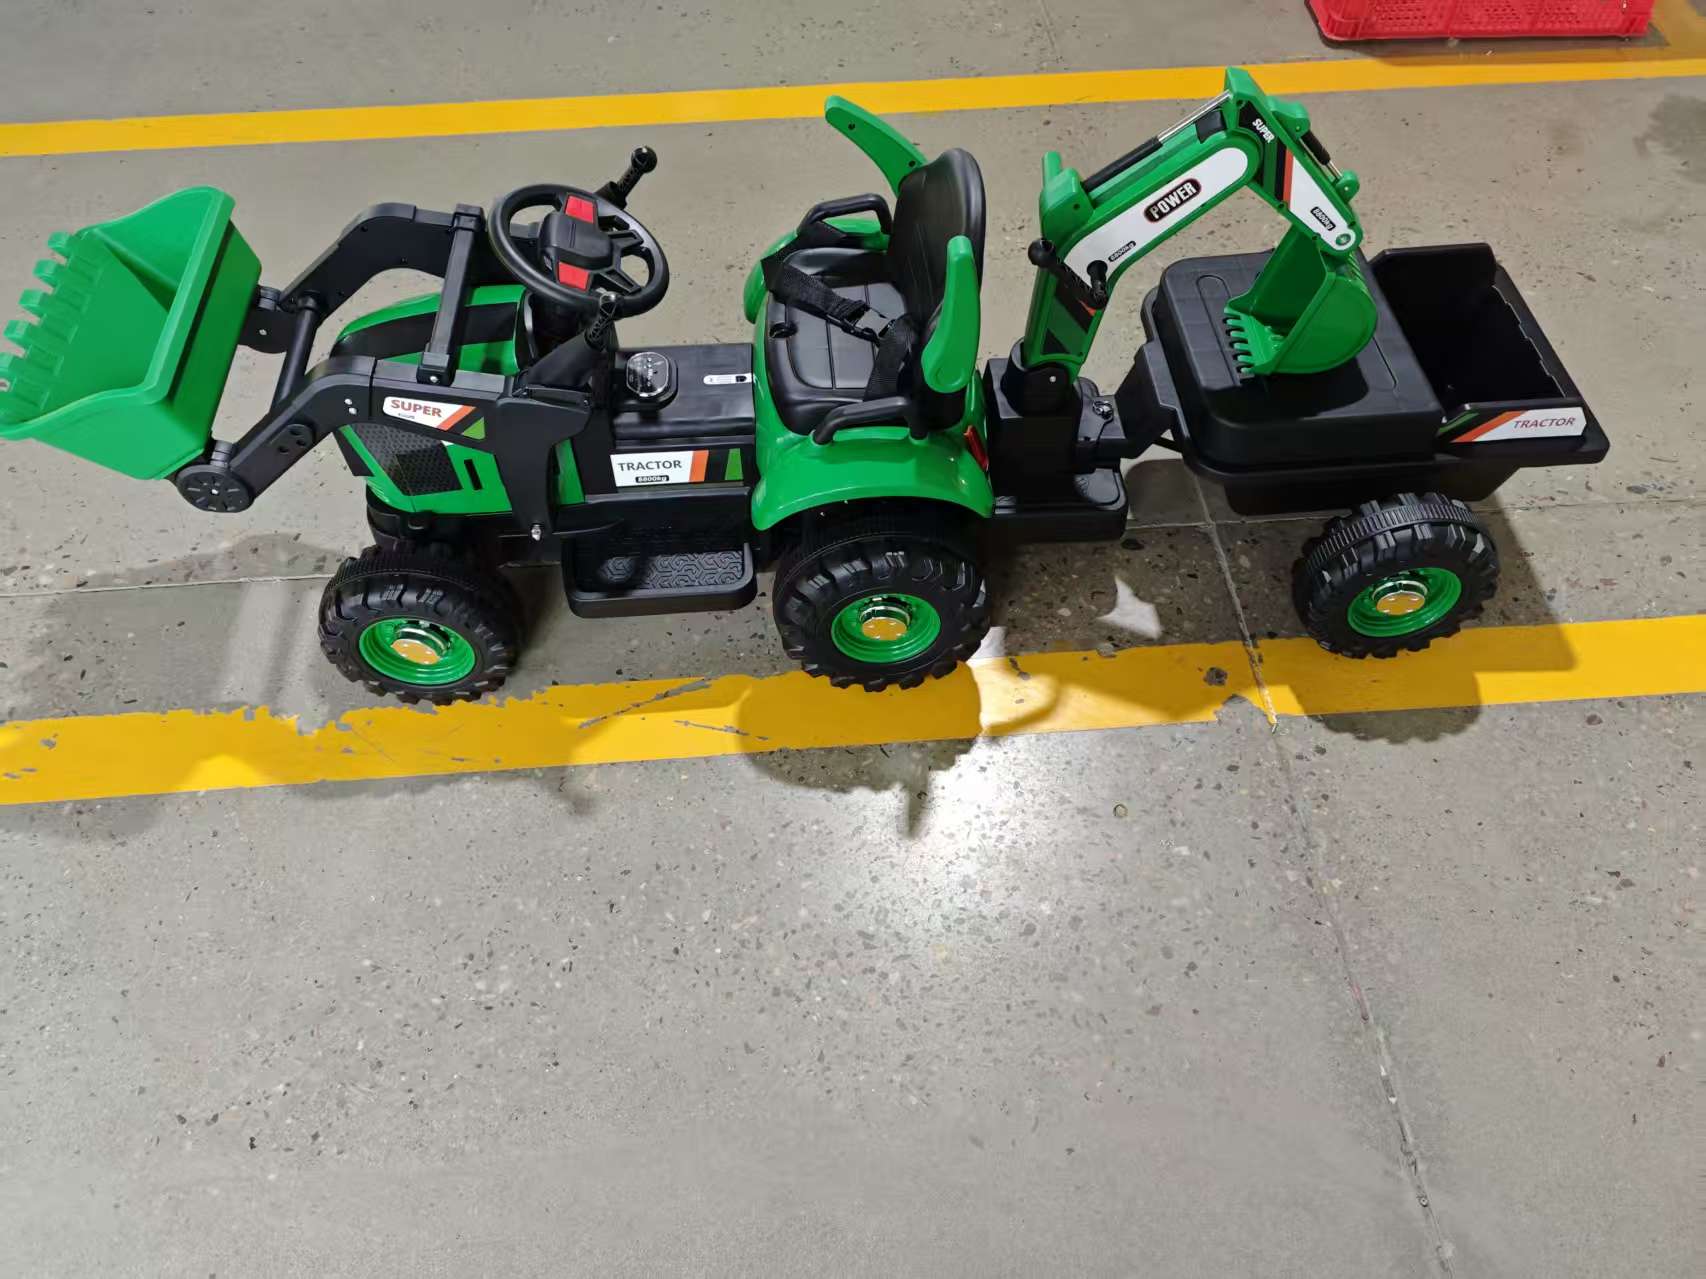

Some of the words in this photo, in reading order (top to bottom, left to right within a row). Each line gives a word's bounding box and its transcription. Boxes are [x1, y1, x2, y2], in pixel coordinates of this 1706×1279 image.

[1252, 118, 1275, 143] SUPER
[1149, 182, 1198, 219] POWER
[391, 399, 442, 418] SUPER
[1513, 417, 1575, 429] TRACTOR
[617, 460, 682, 472] TRACTOR
